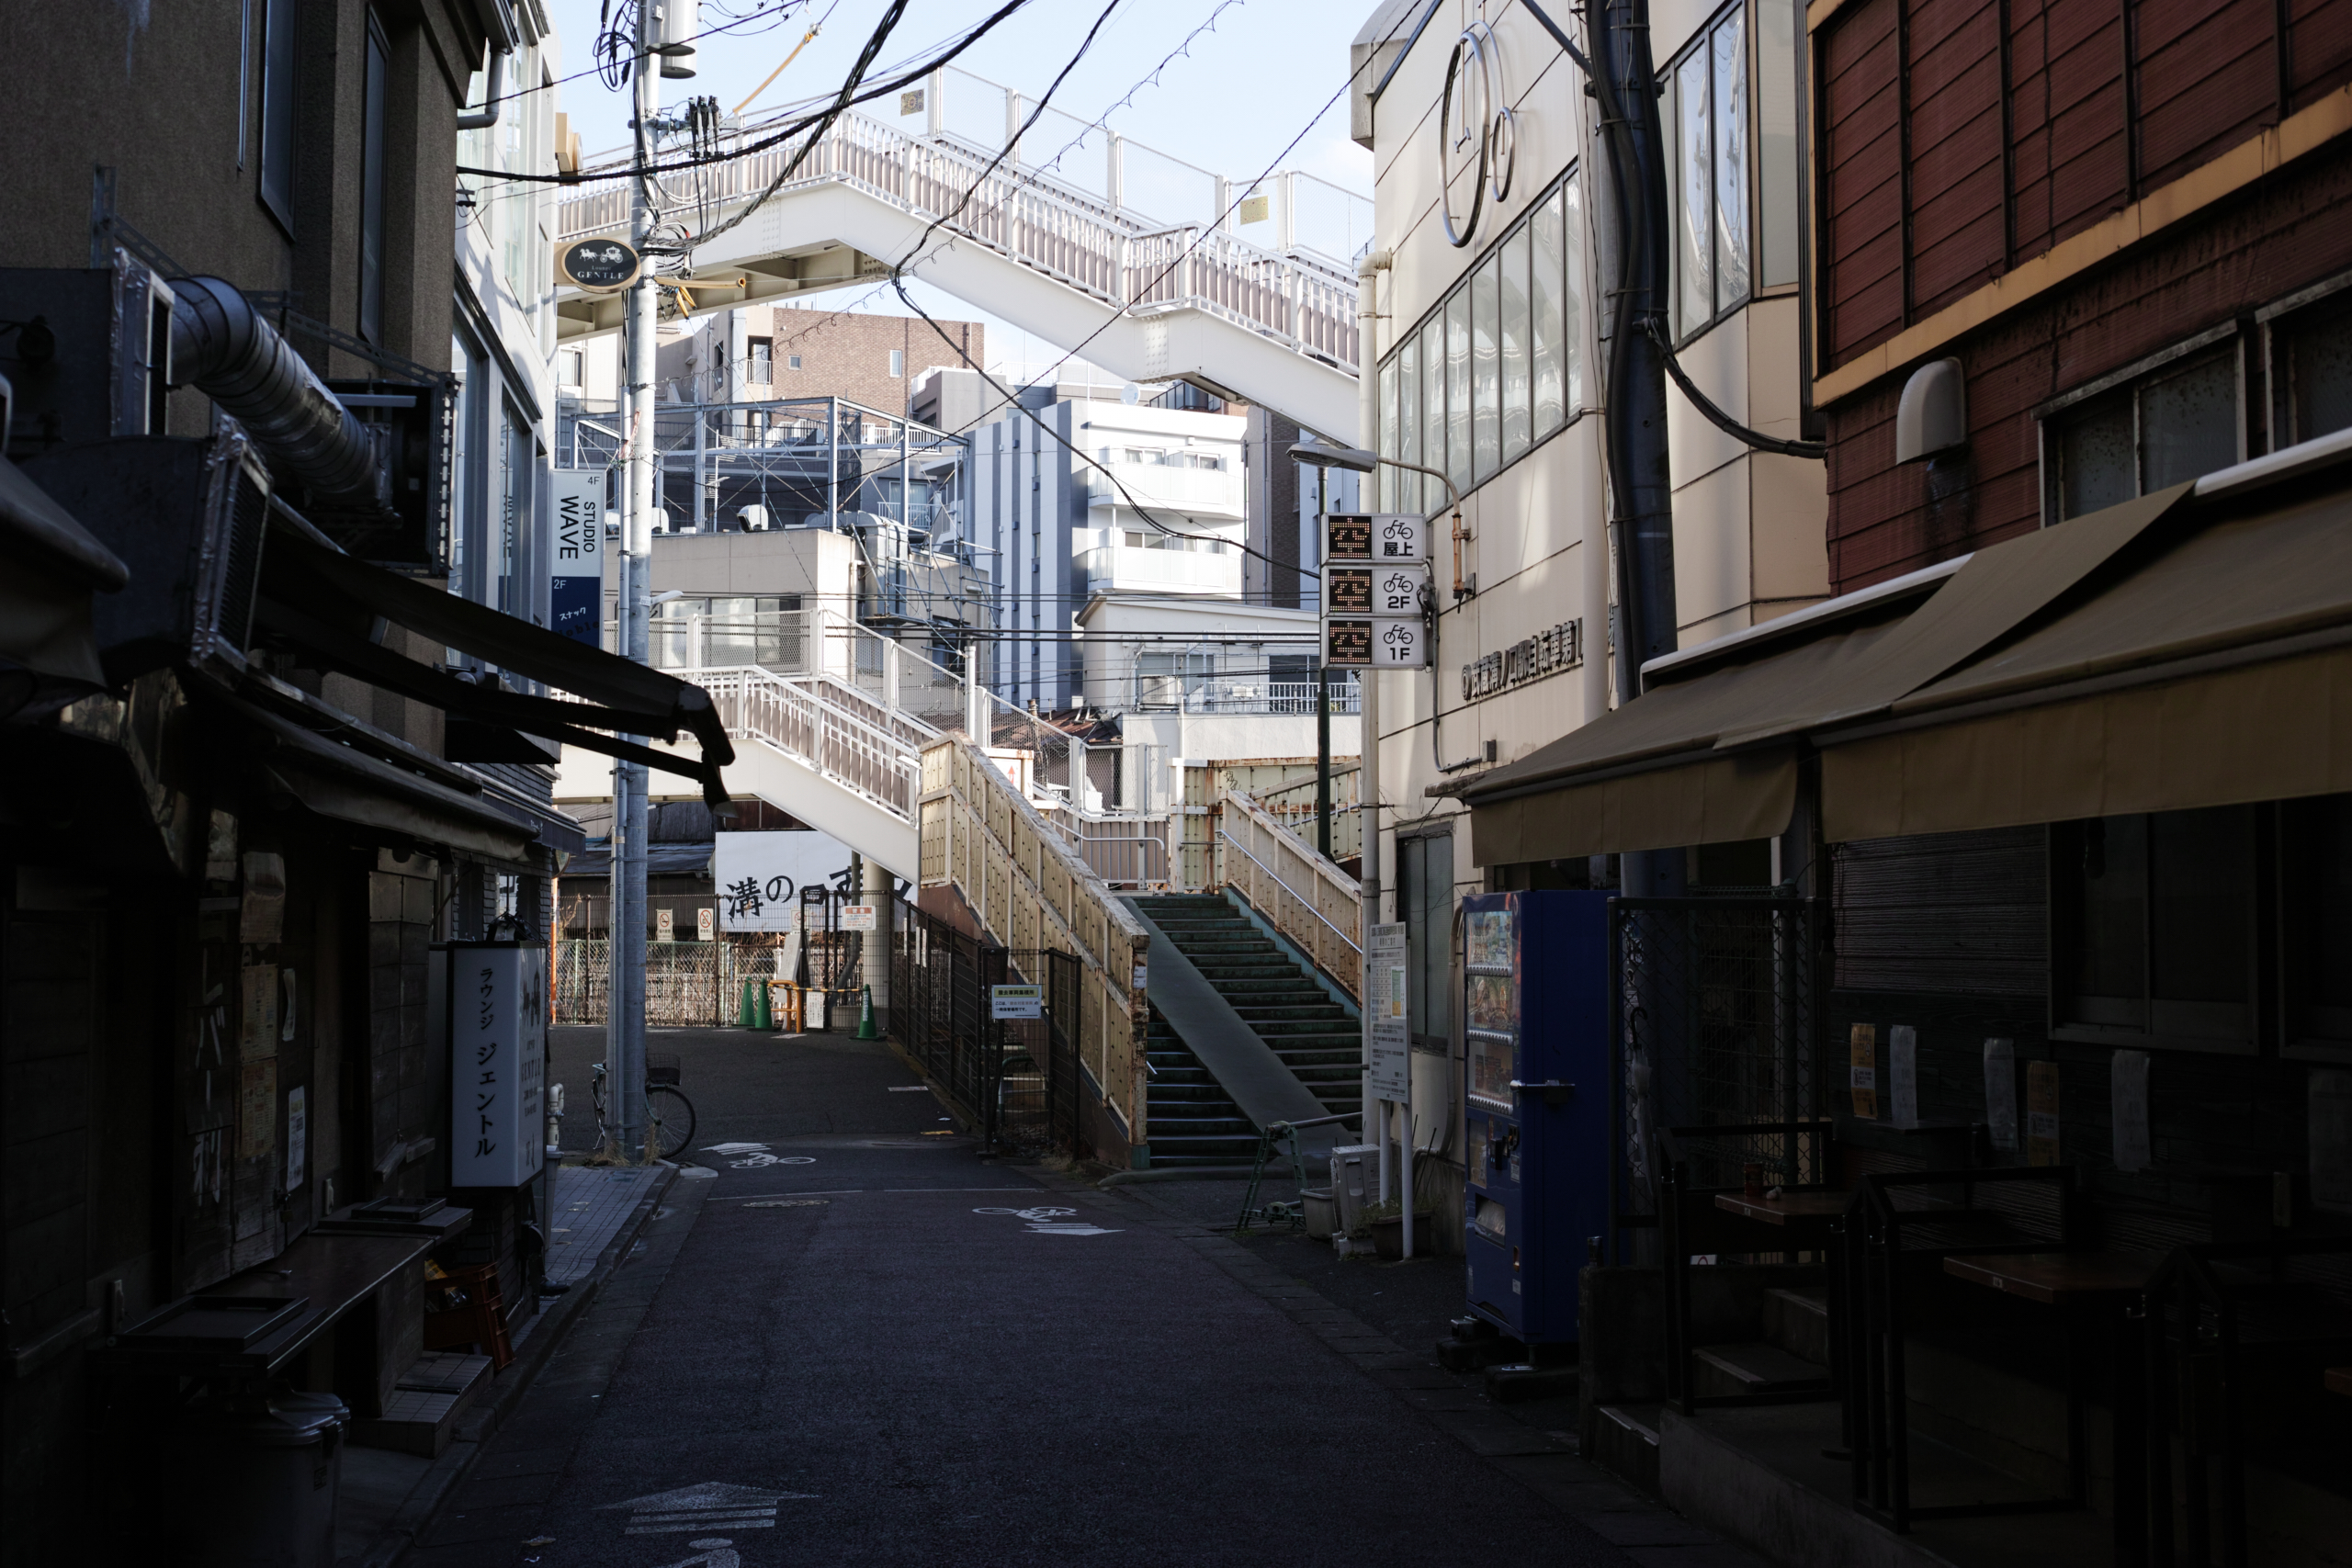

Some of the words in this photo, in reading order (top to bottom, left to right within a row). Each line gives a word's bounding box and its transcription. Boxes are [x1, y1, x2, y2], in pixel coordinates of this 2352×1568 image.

[577, 271, 625, 279] GENTLE
[587, 476, 601, 485] 4F
[560, 495, 580, 560] WAVE
[583, 501, 596, 553] STUDIO
[1329, 517, 1370, 558] 空
[1383, 541, 1414, 557] 屋上
[553, 580, 567, 590] 2F
[1329, 570, 1370, 612] 空
[1387, 595, 1410, 609] 2F
[559, 606, 587, 622] スナック
[558, 621, 600, 637] oble
[1329, 622, 1370, 663] 空
[1389, 647, 1410, 660] 1F
[480, 967, 494, 1031] ラウンジ
[521, 1057, 541, 1082] GENTLE
[474, 1042, 498, 1159] ジェントル
